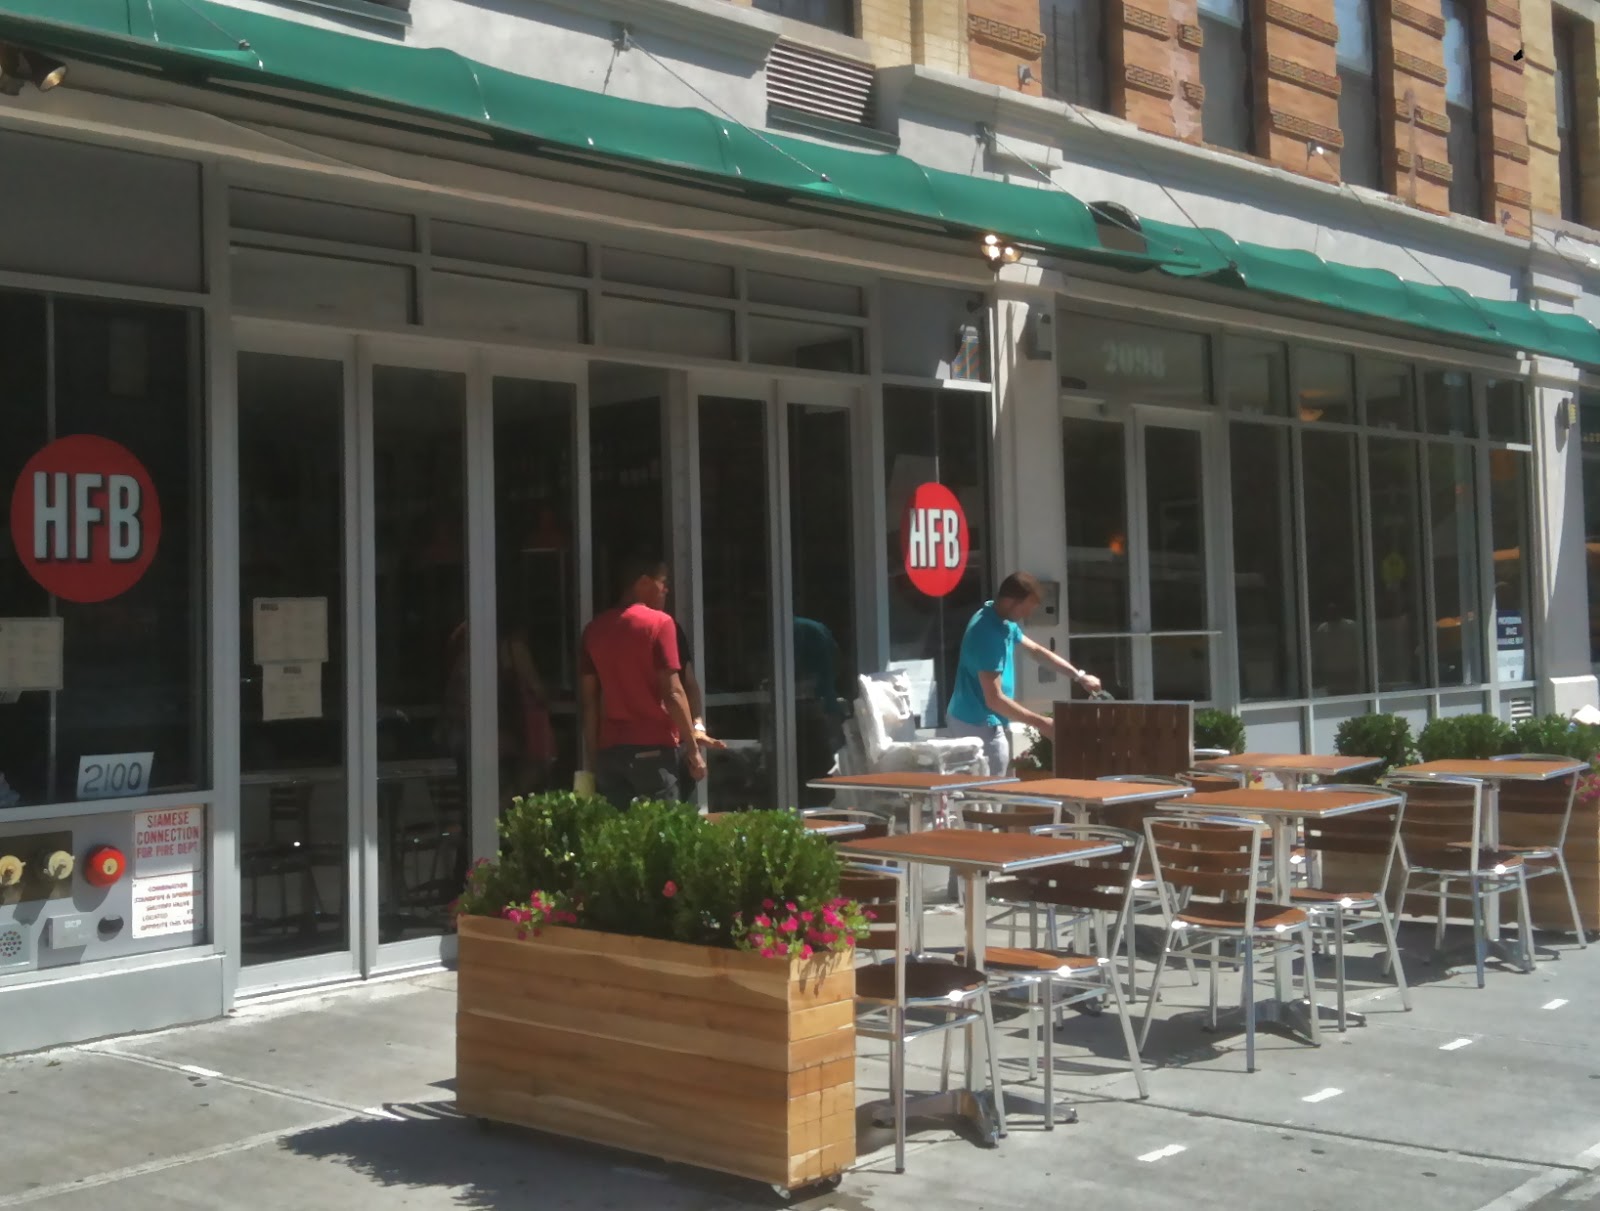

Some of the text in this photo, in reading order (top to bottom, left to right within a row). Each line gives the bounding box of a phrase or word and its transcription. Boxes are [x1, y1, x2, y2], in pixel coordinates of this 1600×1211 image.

[34, 471, 141, 561] HFB
[909, 508, 960, 568] HFB
[83, 761, 142, 793] 2100
[147, 811, 189, 828] SIAMESE
[136, 825, 200, 846] CONNECTION
[136, 846, 153, 859] FOR
[155, 843, 175, 857] FIRE
